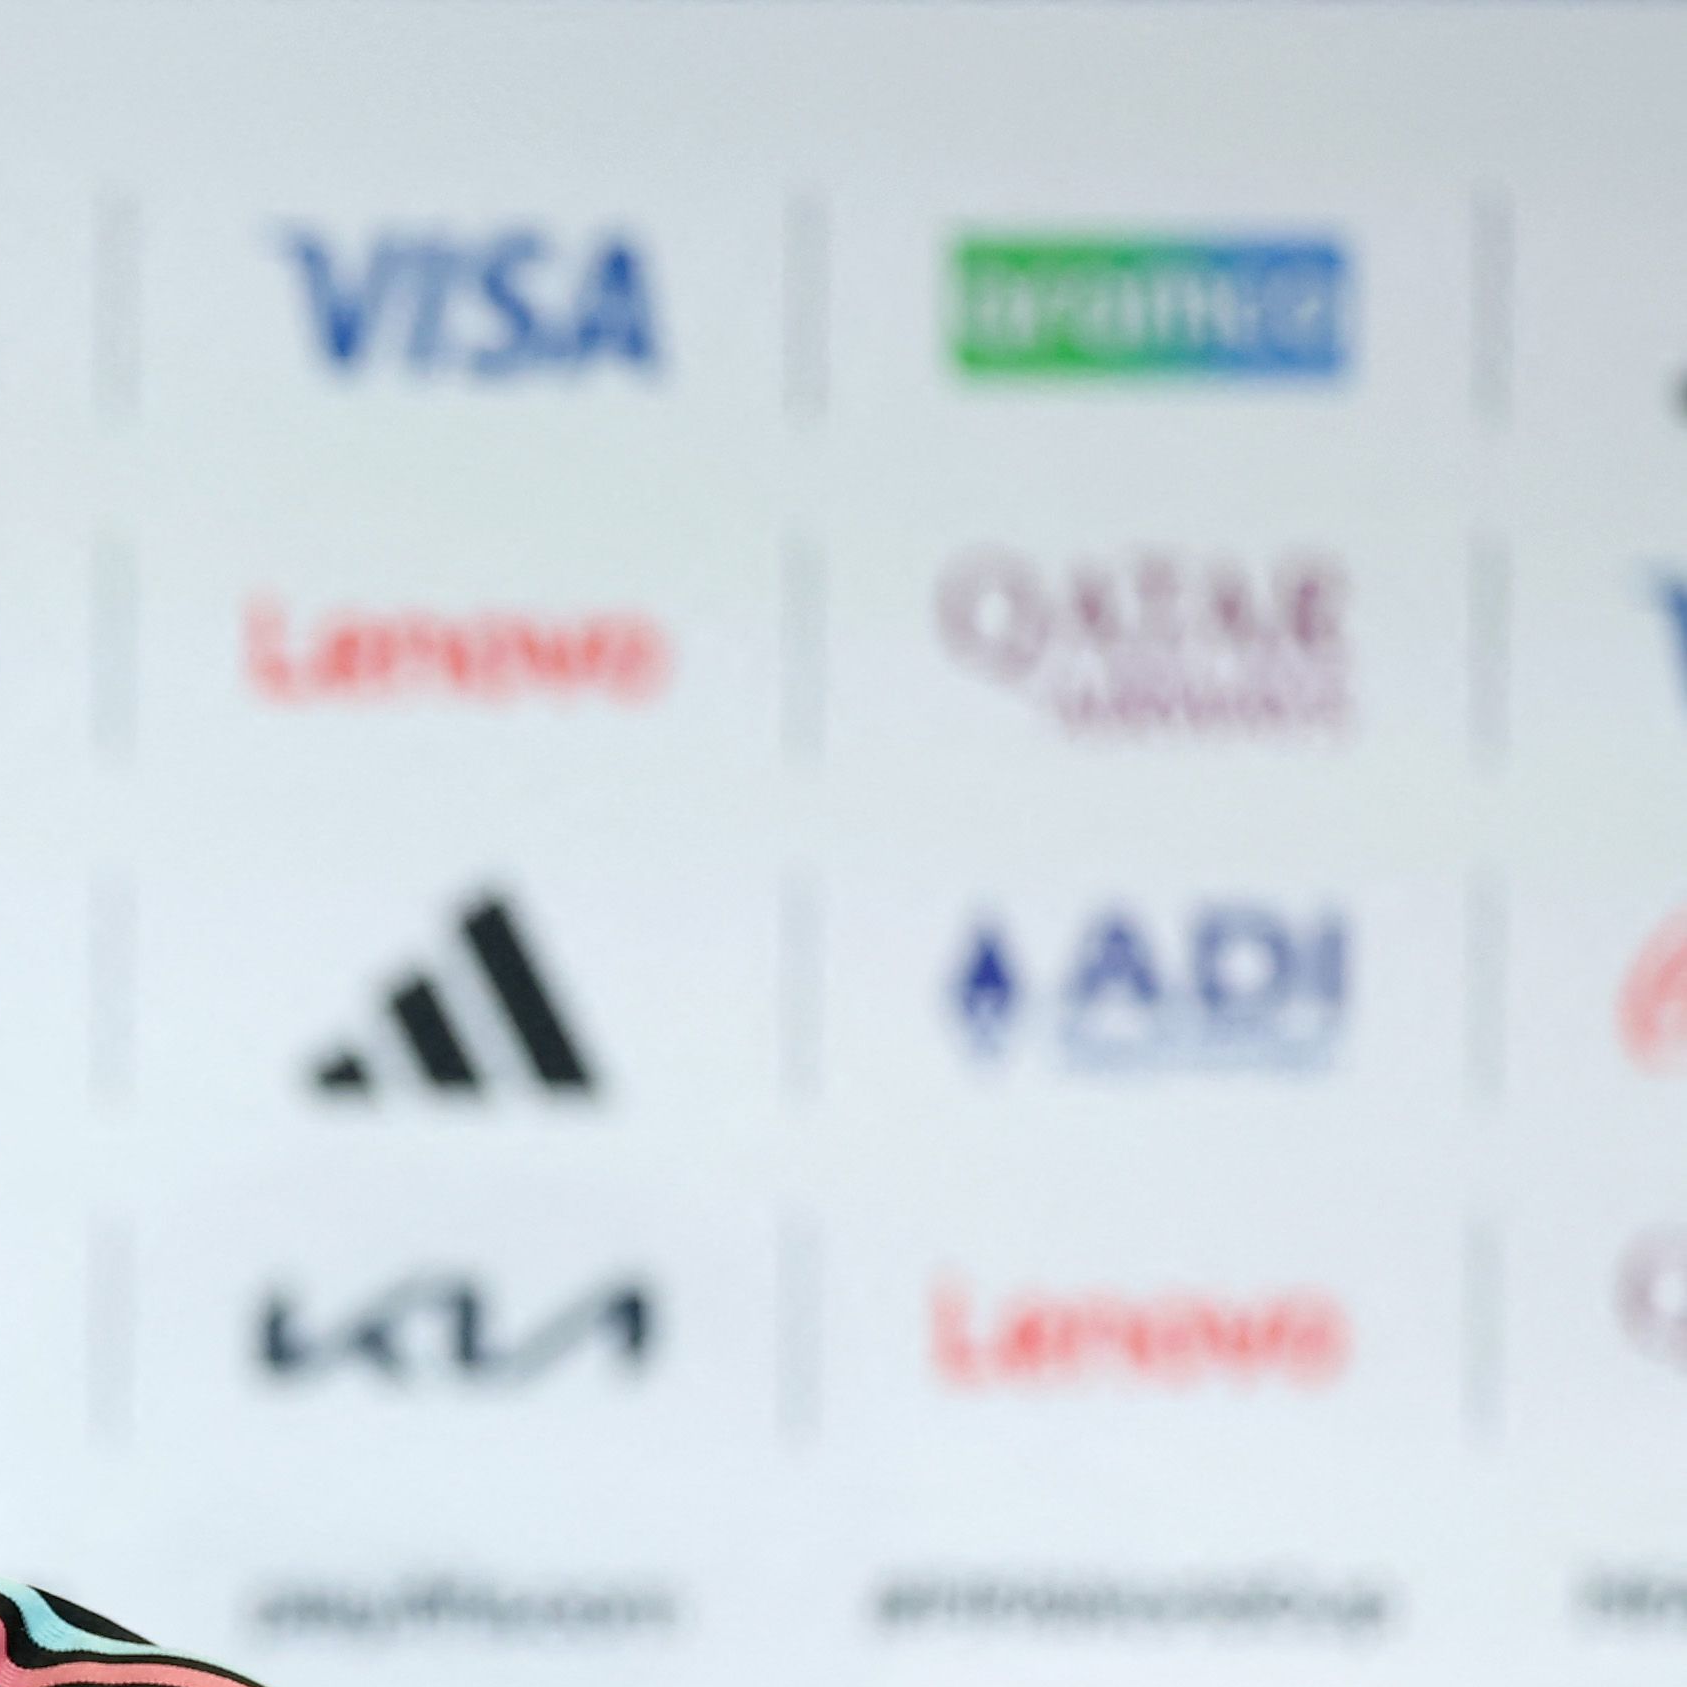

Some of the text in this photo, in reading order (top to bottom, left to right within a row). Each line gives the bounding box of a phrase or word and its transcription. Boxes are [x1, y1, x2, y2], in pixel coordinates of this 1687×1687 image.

[280, 228, 663, 379] VISA
[249, 603, 666, 699] Lenovo
[1065, 906, 1347, 1005] ADI
[931, 1274, 1350, 1386] Lenovo
